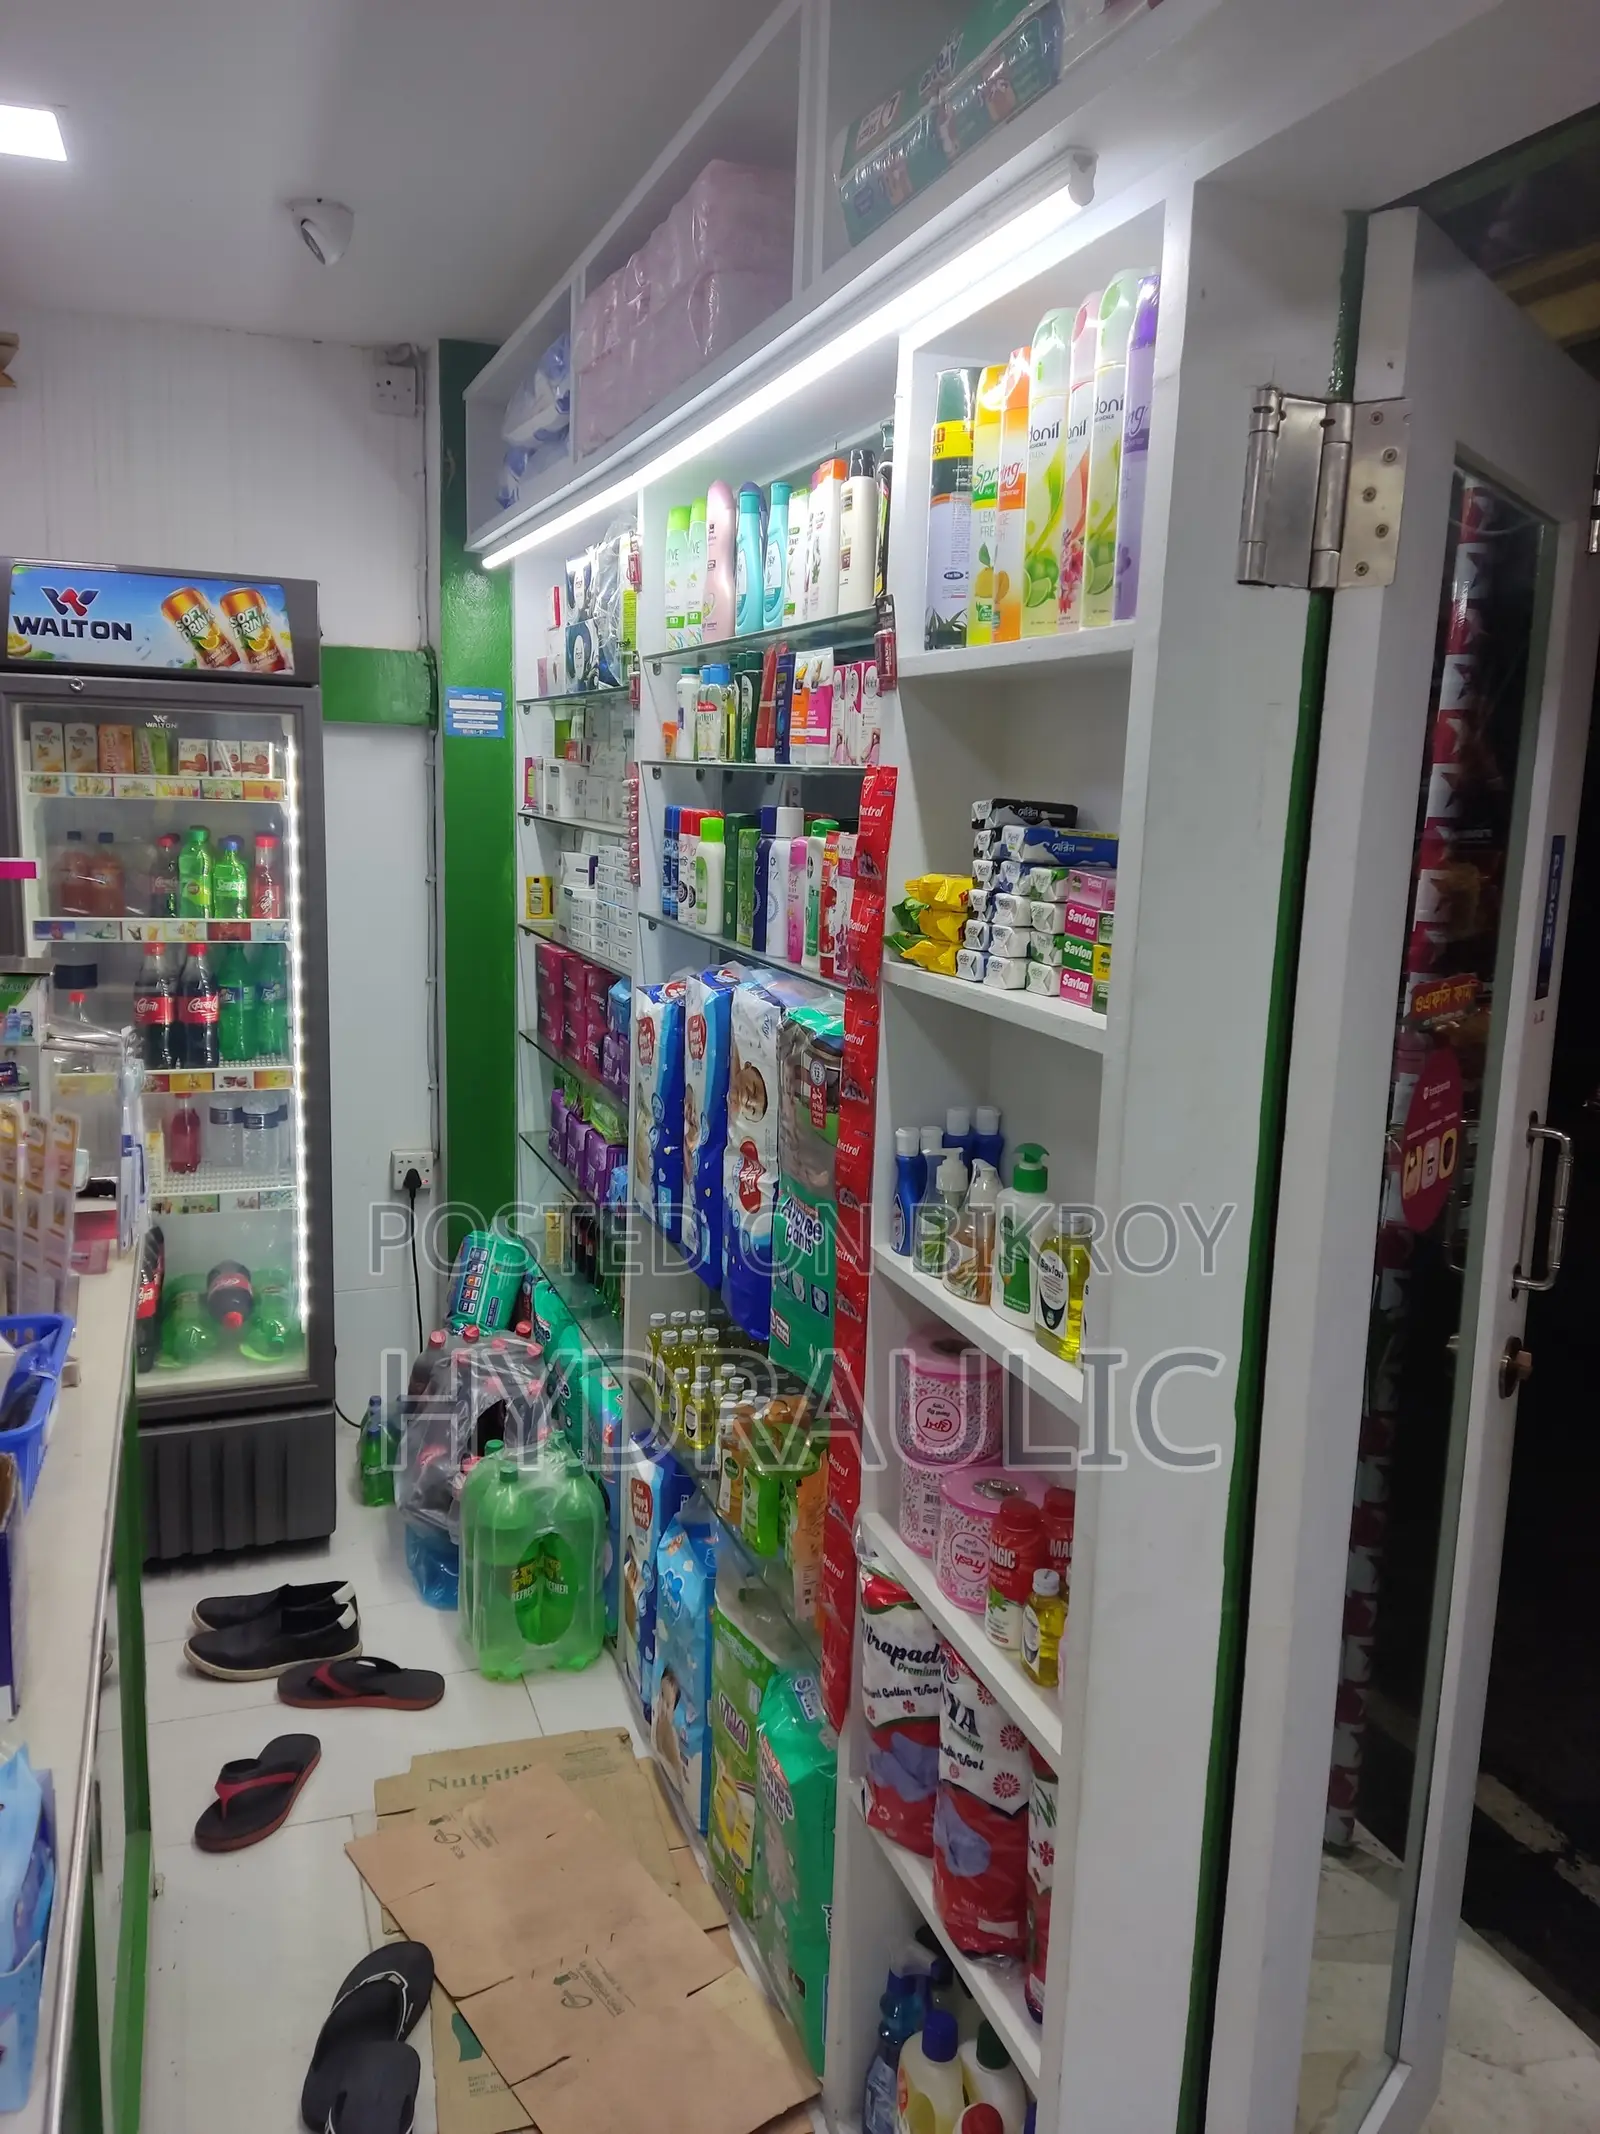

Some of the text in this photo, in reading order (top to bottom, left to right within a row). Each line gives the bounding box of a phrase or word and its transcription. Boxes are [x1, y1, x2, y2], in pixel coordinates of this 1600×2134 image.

[12, 615, 132, 641] WALTON
[181, 609, 216, 643] DRINK
[233, 612, 271, 639] DRINK
[1067, 909, 1097, 928] Savlon
[1064, 941, 1092, 959] Savlon
[1062, 974, 1089, 992] Savlon
